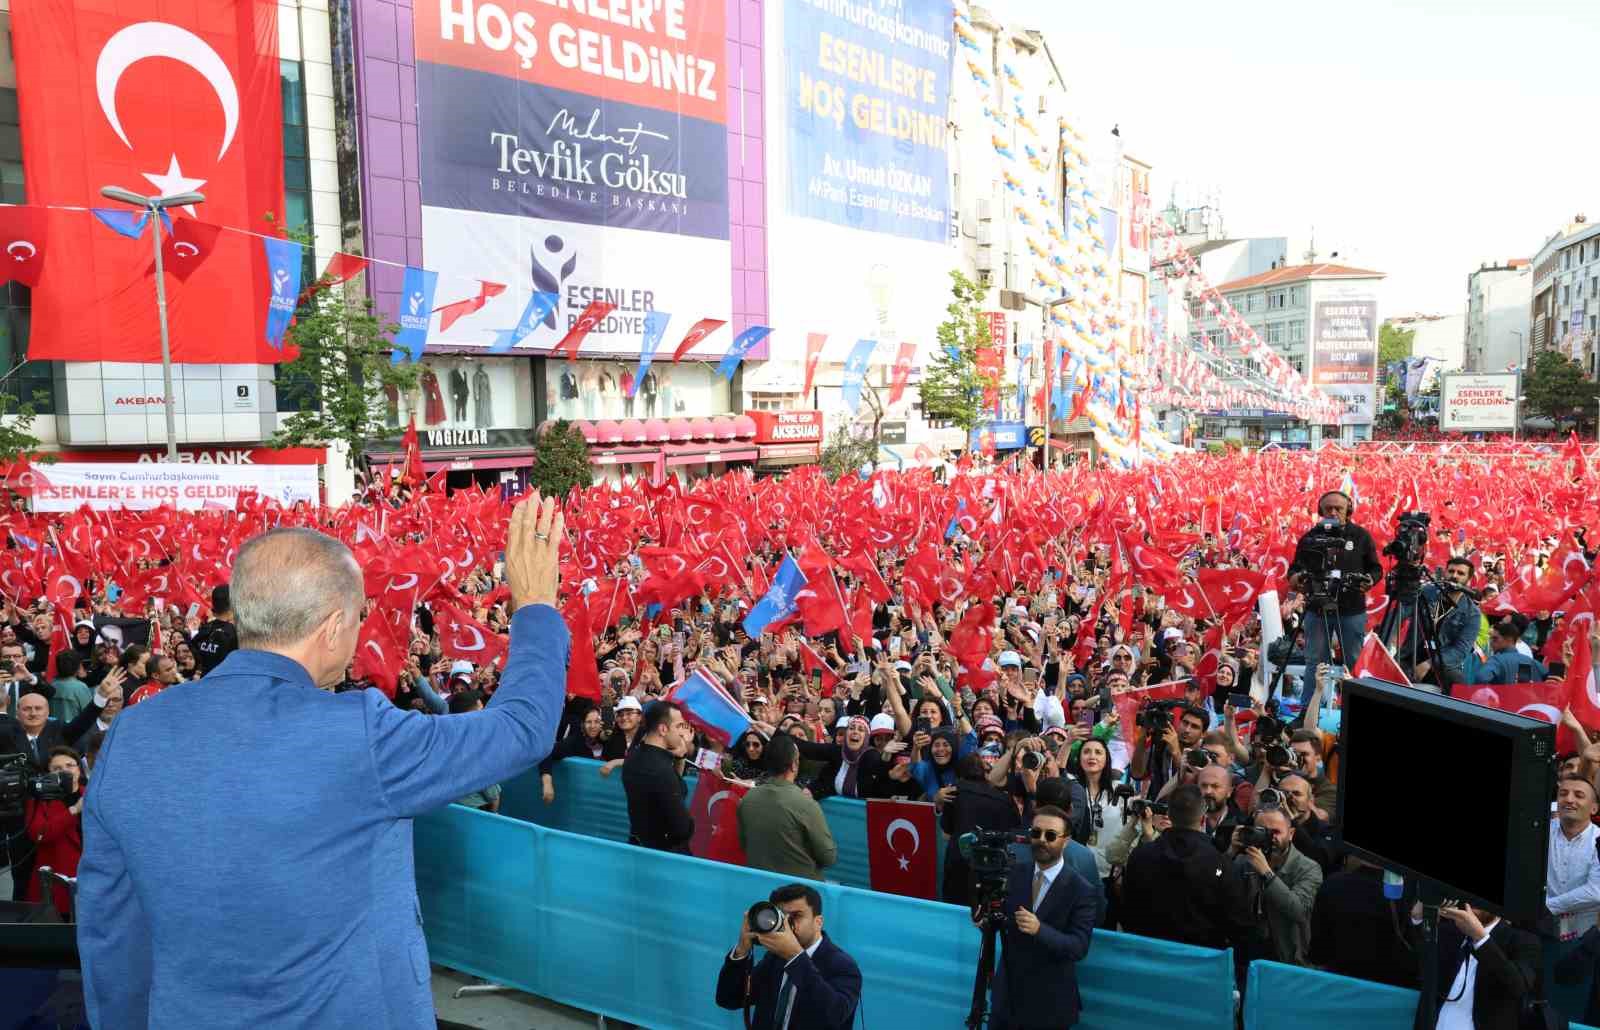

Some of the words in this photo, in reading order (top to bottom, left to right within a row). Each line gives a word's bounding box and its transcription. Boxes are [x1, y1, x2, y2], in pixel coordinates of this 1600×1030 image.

[440, 0, 538, 69] HOŞ
[820, 31, 936, 104] ESENLER'E
[546, 108, 670, 154] Mehmet
[491, 131, 596, 184] Tevfik
[600, 152, 688, 198] Göksu
[847, 160, 886, 187] Umut
[888, 160, 931, 197] ÖZKAN
[492, 178, 598, 203] BELEDİYE
[612, 195, 688, 215] BAŞKANI
[567, 285, 654, 312] ESENLER
[567, 313, 656, 335] BEDİYESİ
[1450, 398, 1468, 406] HOŞ
[1458, 389, 1503, 398] ESENLER'E
[772, 424, 820, 440] AKSESUAR
[137, 449, 255, 465] AKBANK
[84, 471, 116, 483] Sayın
